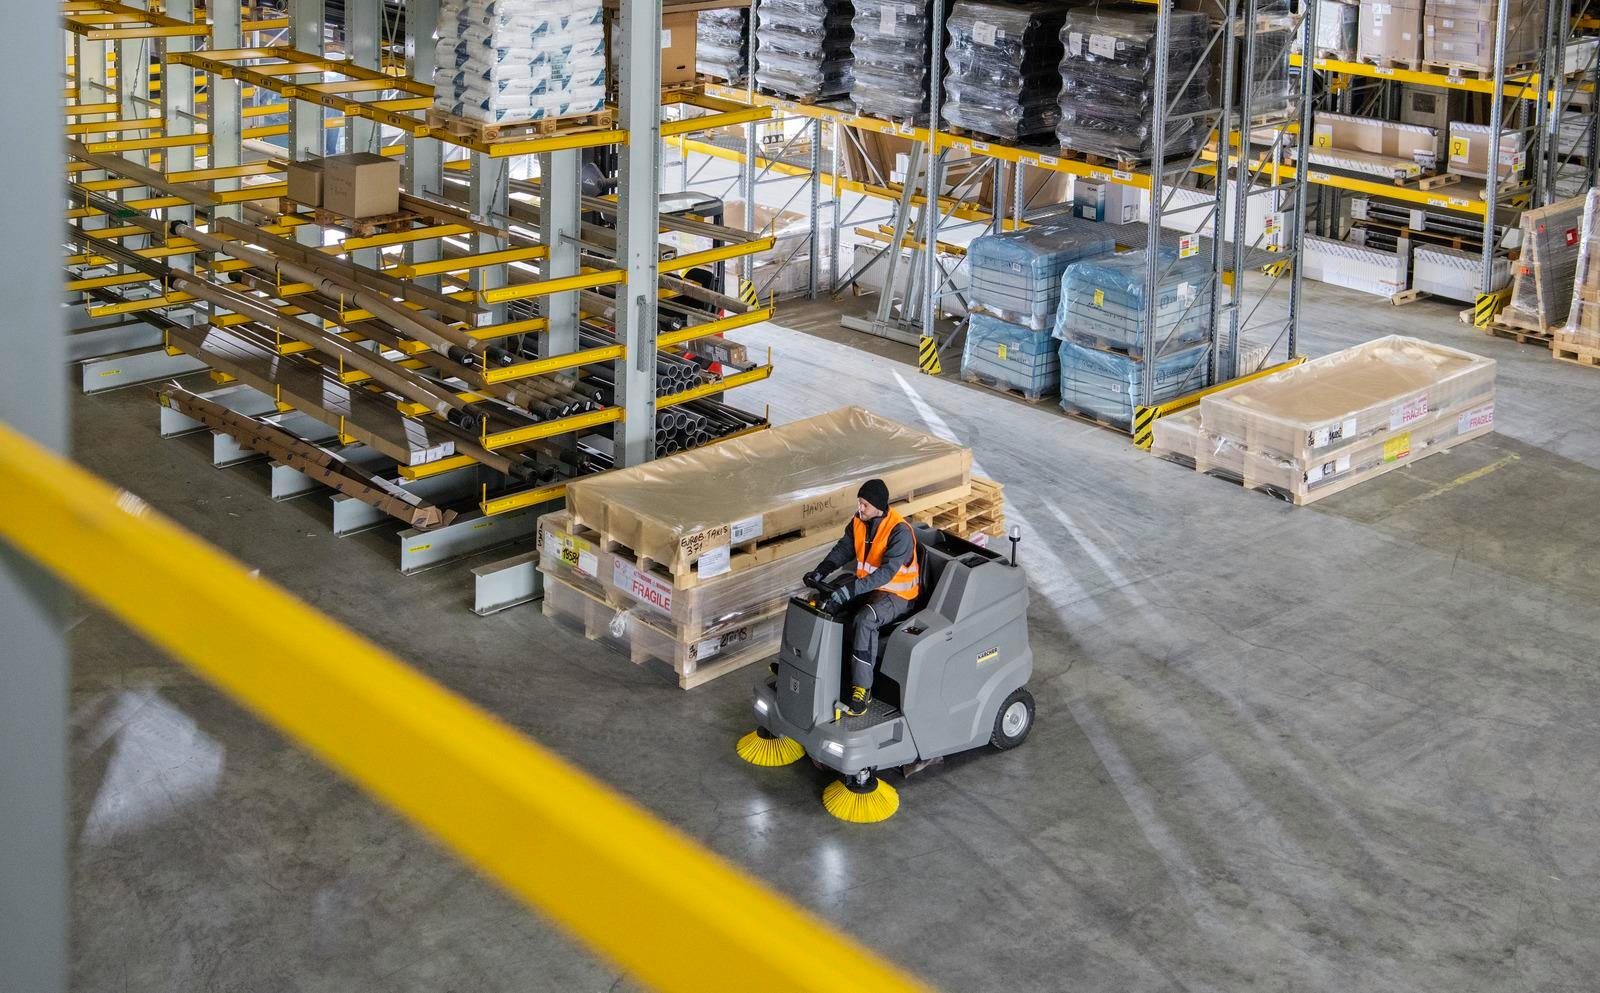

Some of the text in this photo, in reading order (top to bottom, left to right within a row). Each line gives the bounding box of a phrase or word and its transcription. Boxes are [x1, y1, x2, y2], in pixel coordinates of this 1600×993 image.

[1402, 403, 1428, 423] FRAGILE
[1469, 412, 1494, 429] FRAGILE
[632, 580, 671, 612] FRAGILE
